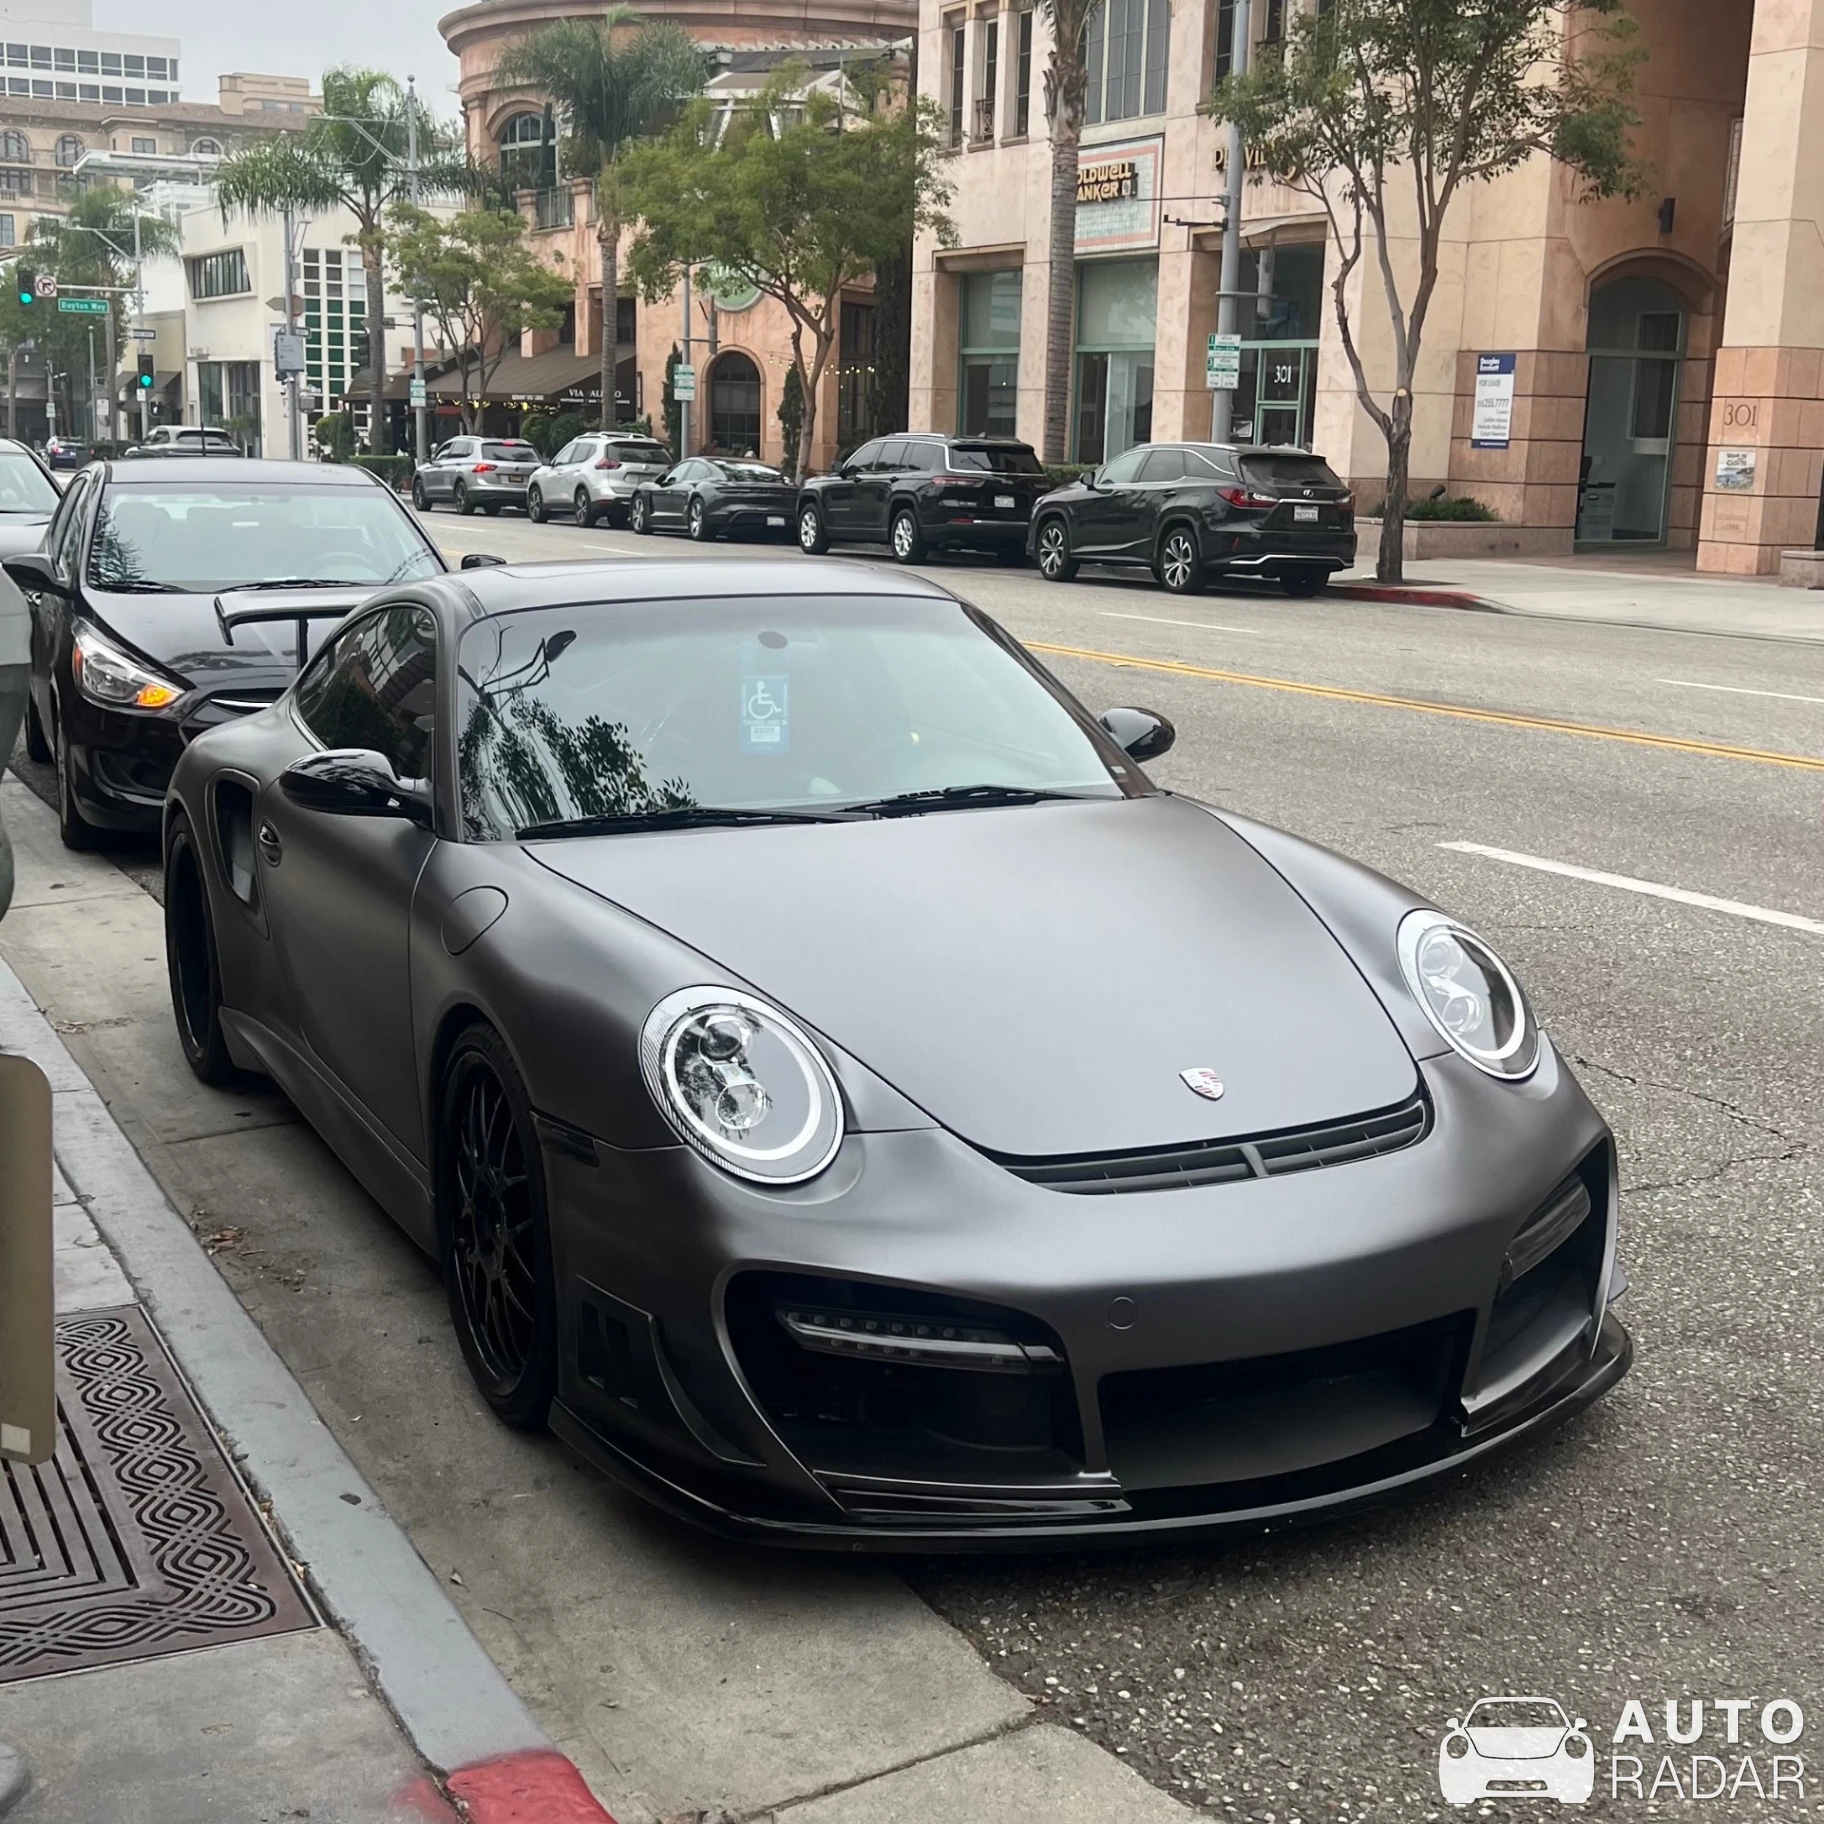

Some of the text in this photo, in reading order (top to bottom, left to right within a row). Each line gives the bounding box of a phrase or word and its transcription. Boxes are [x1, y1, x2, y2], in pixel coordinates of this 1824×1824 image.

[1077, 181, 1119, 202] ANKER
[61, 301, 106, 311] Dayton Way
[1273, 365, 1292, 383] 301
[568, 388, 622, 398] VIA ALLO
[1724, 404, 1757, 426] 301
